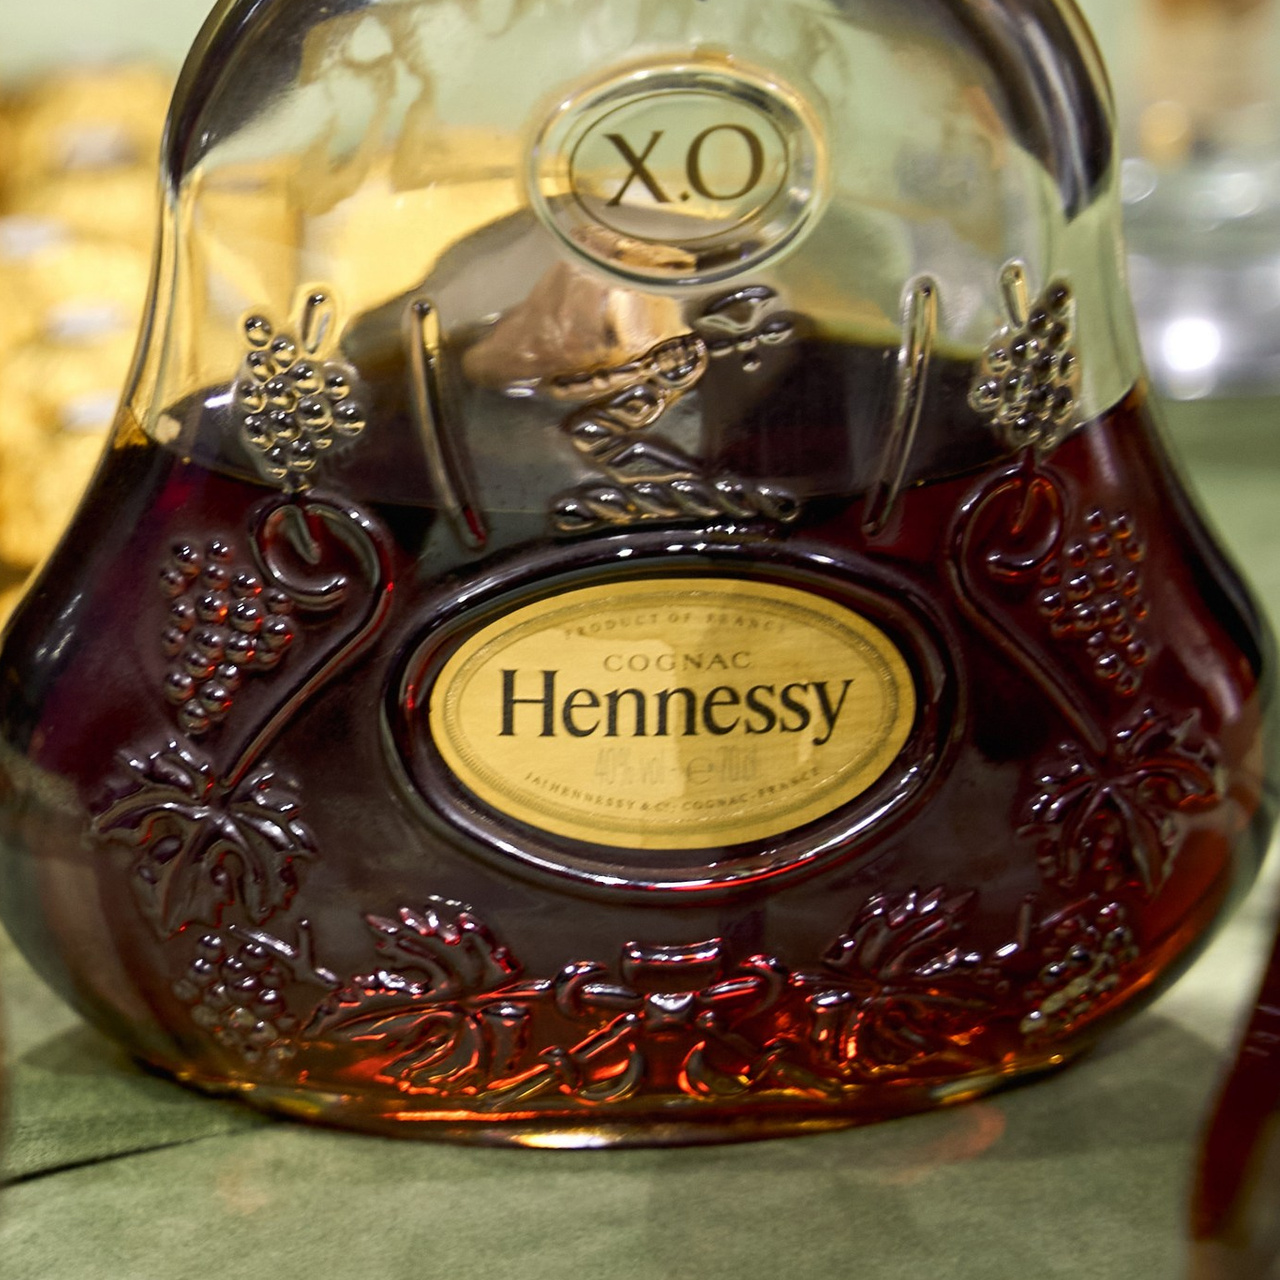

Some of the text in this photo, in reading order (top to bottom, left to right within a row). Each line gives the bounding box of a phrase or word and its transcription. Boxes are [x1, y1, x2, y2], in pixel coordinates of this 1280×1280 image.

[602, 124, 765, 207] X.O
[564, 612, 787, 638] PRODUCT OF FRANCE
[602, 651, 752, 673] COGNAC
[498, 668, 855, 747] Hennessy
